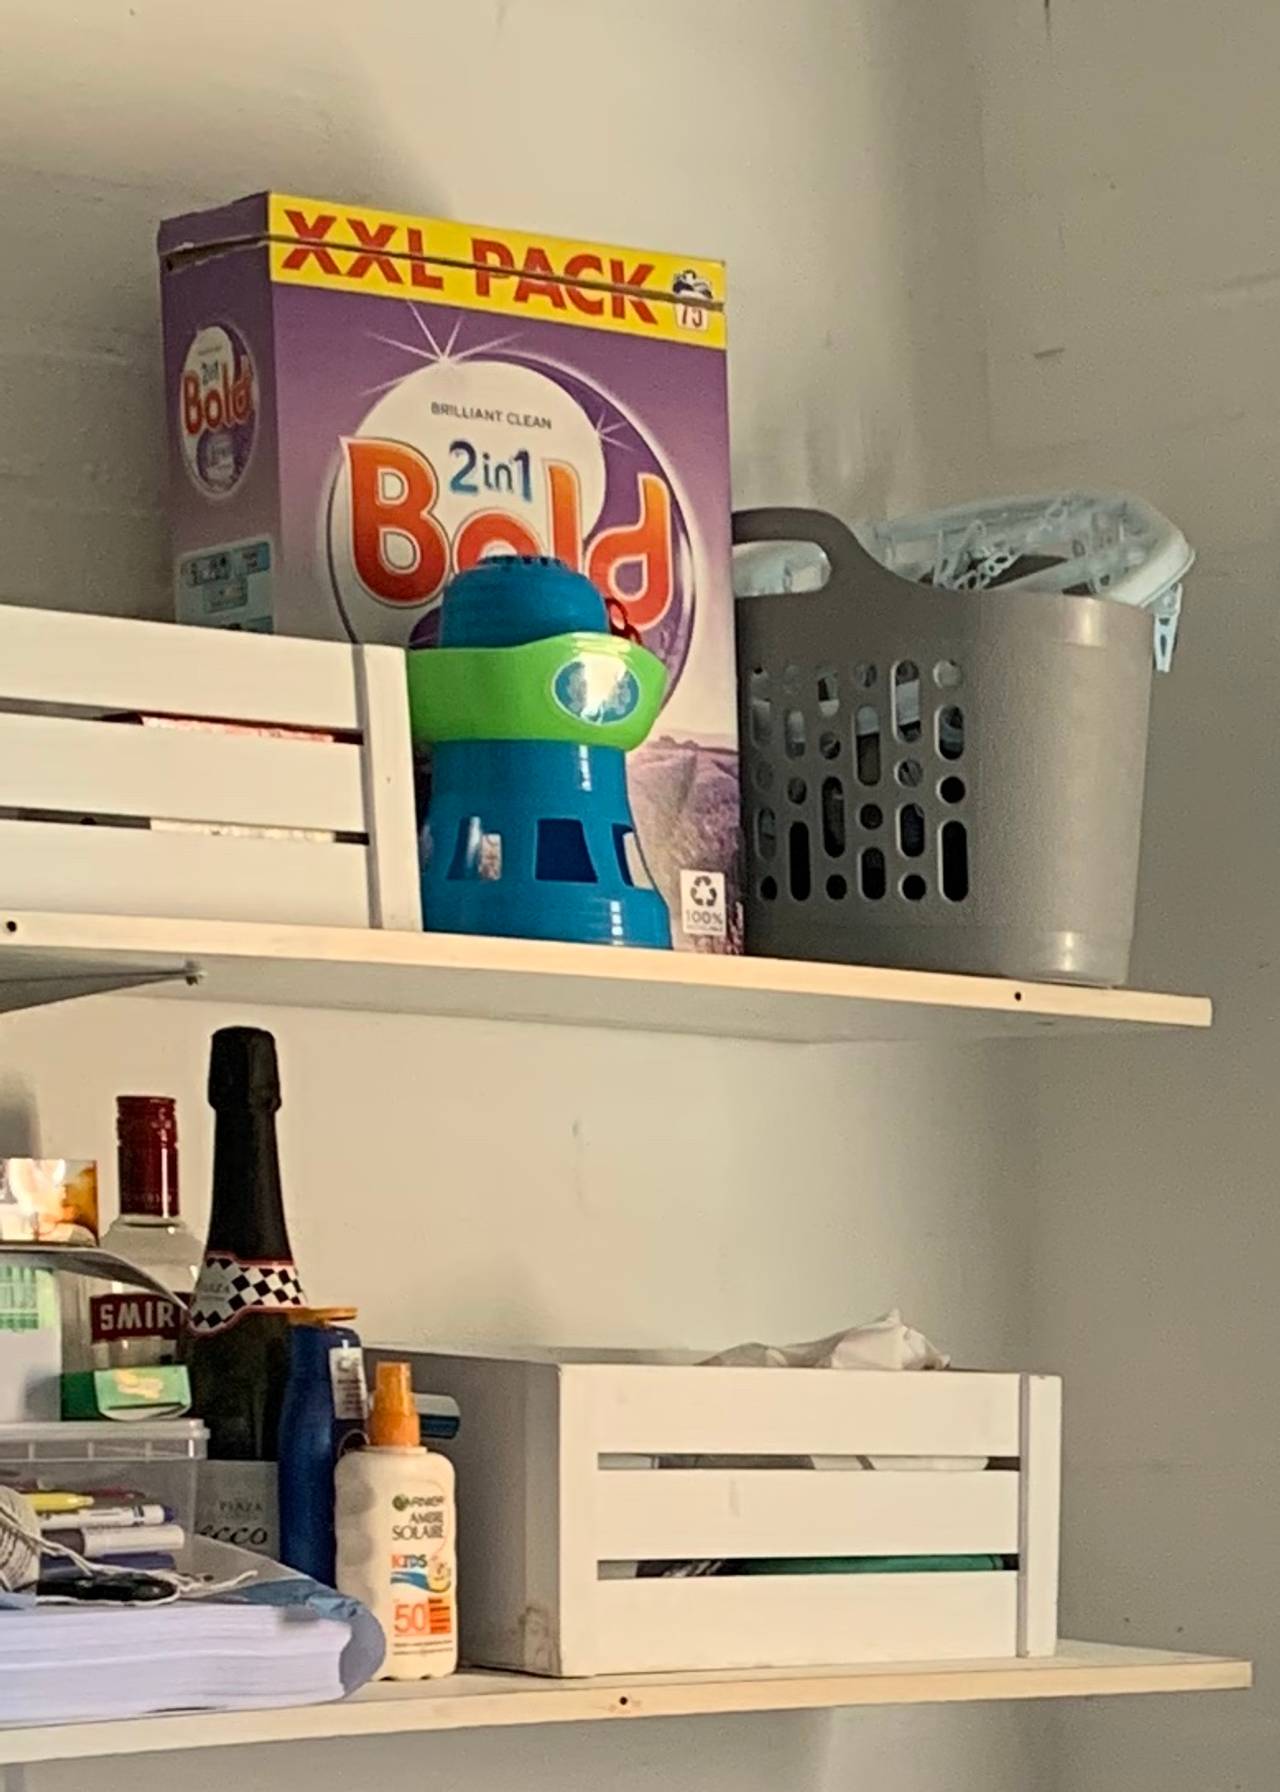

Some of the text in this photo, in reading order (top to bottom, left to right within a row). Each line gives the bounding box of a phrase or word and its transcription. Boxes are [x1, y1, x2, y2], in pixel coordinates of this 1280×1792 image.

[282, 210, 658, 325] XXL PACK
[182, 358, 254, 436] Bold
[431, 402, 552, 430] BRILLIANT CLEAN
[449, 440, 533, 502] 2in1
